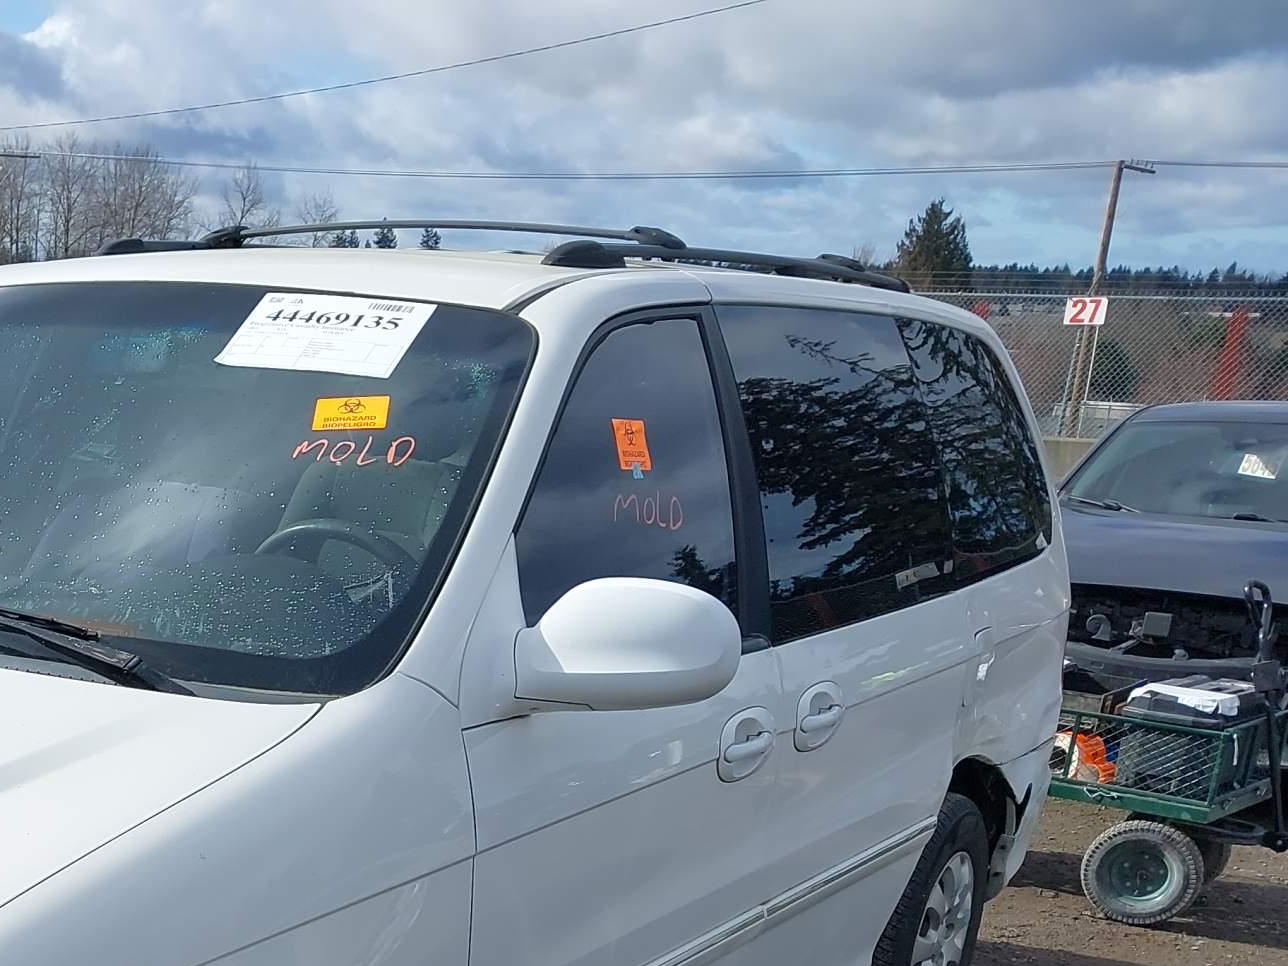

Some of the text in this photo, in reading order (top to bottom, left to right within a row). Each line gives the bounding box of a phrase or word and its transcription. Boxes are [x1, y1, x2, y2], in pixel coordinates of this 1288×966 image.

[264, 309, 404, 331] 44469135
[1069, 298, 1102, 323] 27
[323, 415, 377, 423] BIOHAZARD
[292, 435, 416, 466] MOLD
[614, 490, 683, 530] MOLD
